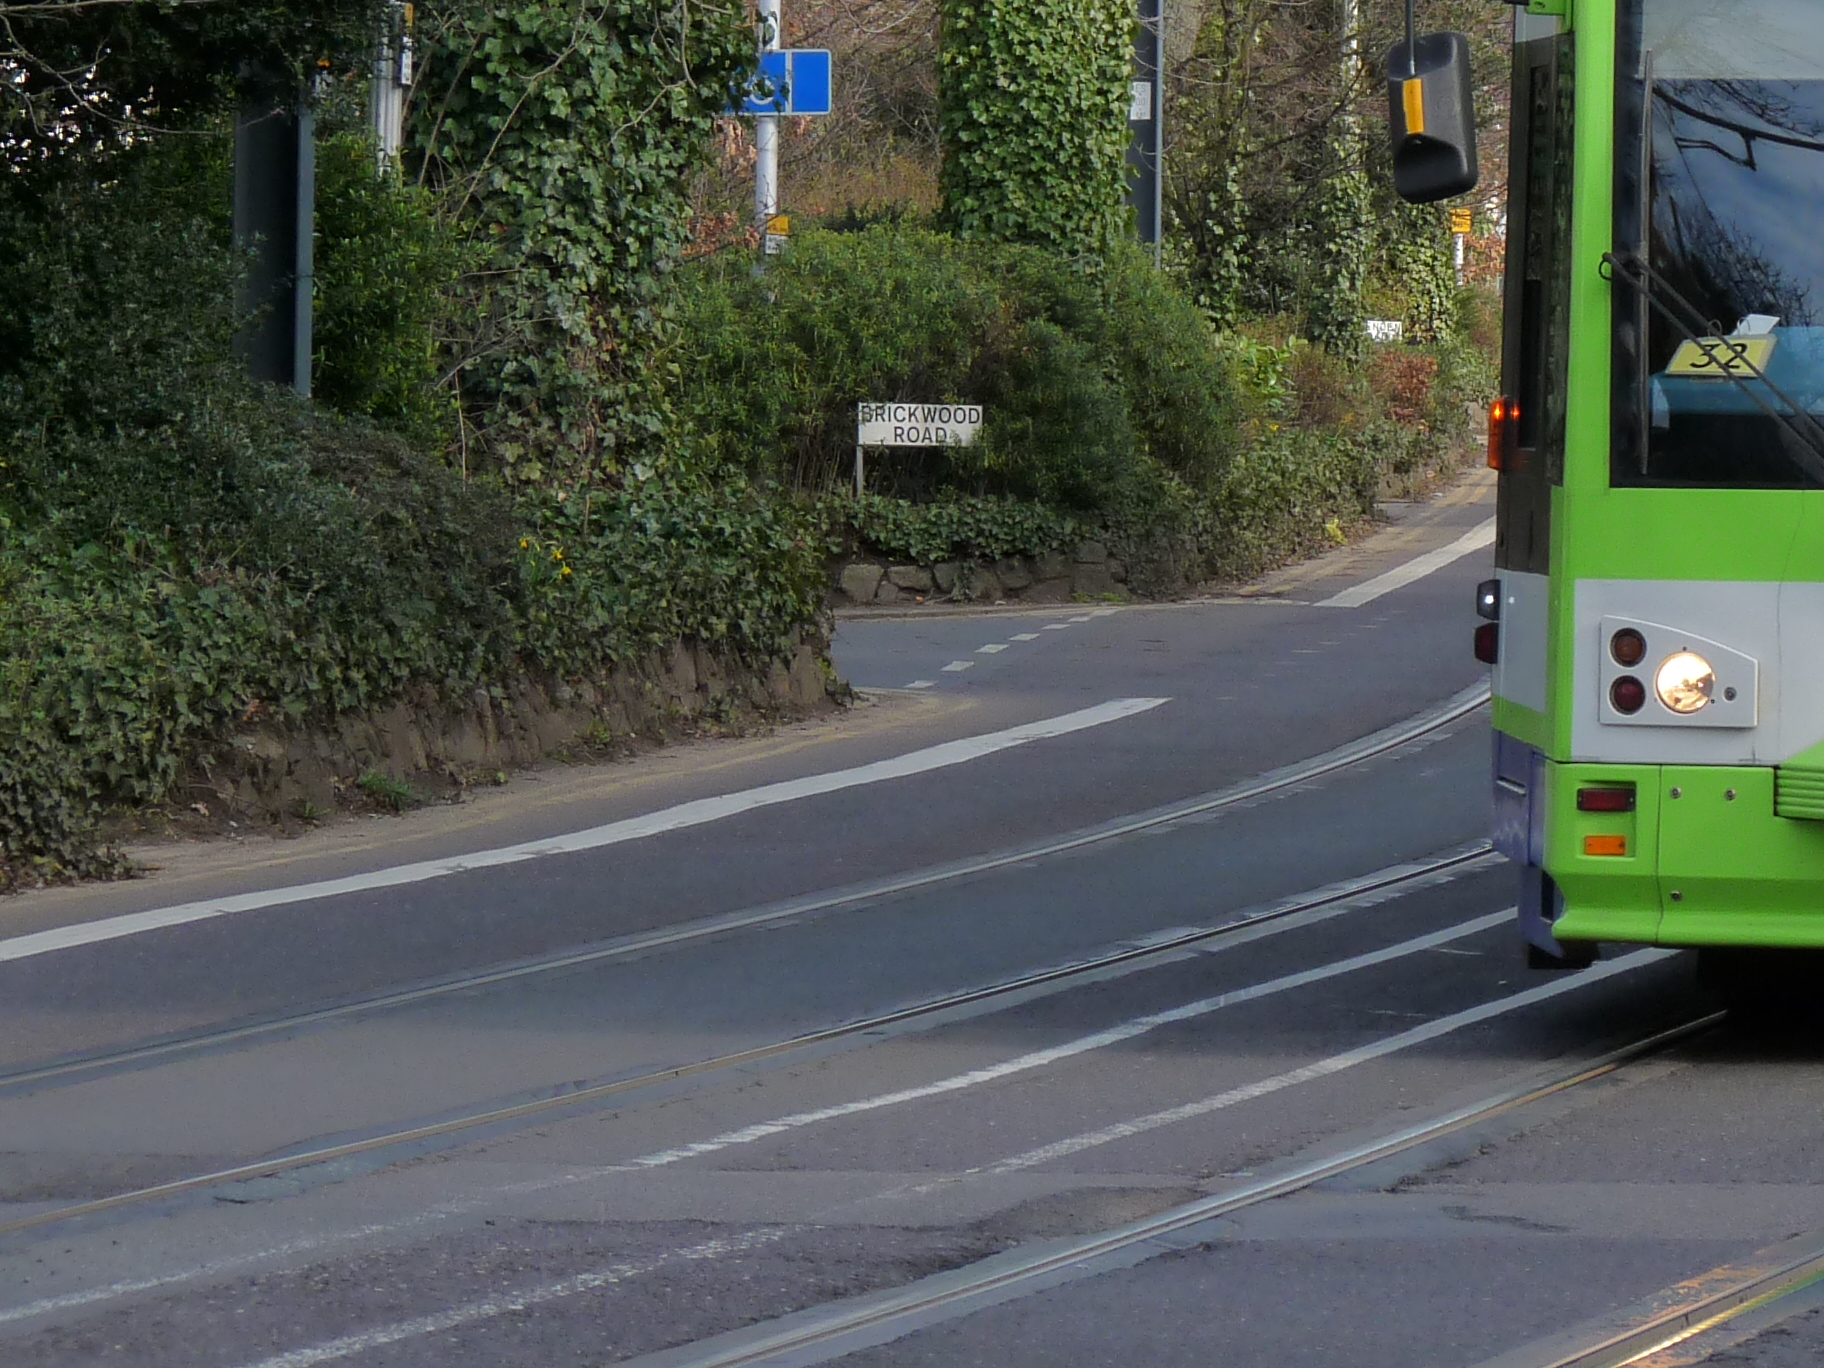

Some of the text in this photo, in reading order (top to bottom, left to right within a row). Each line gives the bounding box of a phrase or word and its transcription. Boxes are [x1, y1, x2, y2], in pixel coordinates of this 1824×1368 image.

[1689, 342, 1748, 369] 32
[861, 405, 980, 424] BRICKWOOD
[894, 426, 947, 443] ROAD
